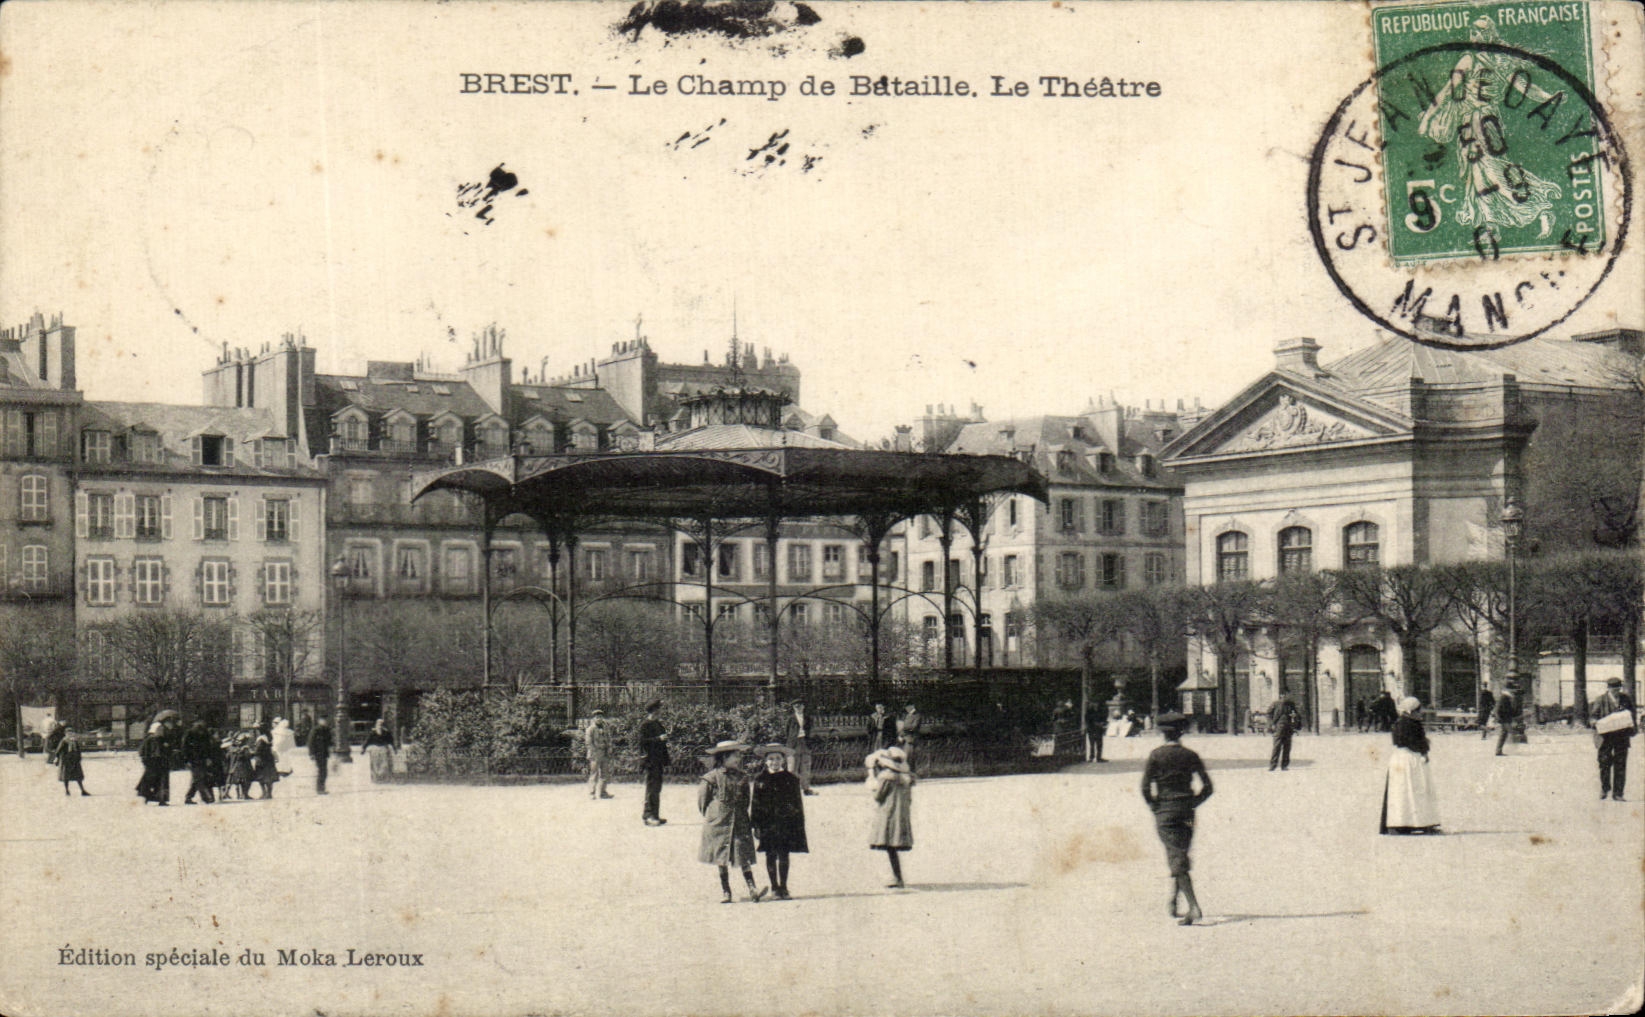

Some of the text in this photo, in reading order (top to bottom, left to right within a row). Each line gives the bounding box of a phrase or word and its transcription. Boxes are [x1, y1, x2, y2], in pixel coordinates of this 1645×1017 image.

[1381, 4, 1581, 34] REPUBLIQUE FRANÇAISE
[1571, 151, 1595, 234] POSTES
